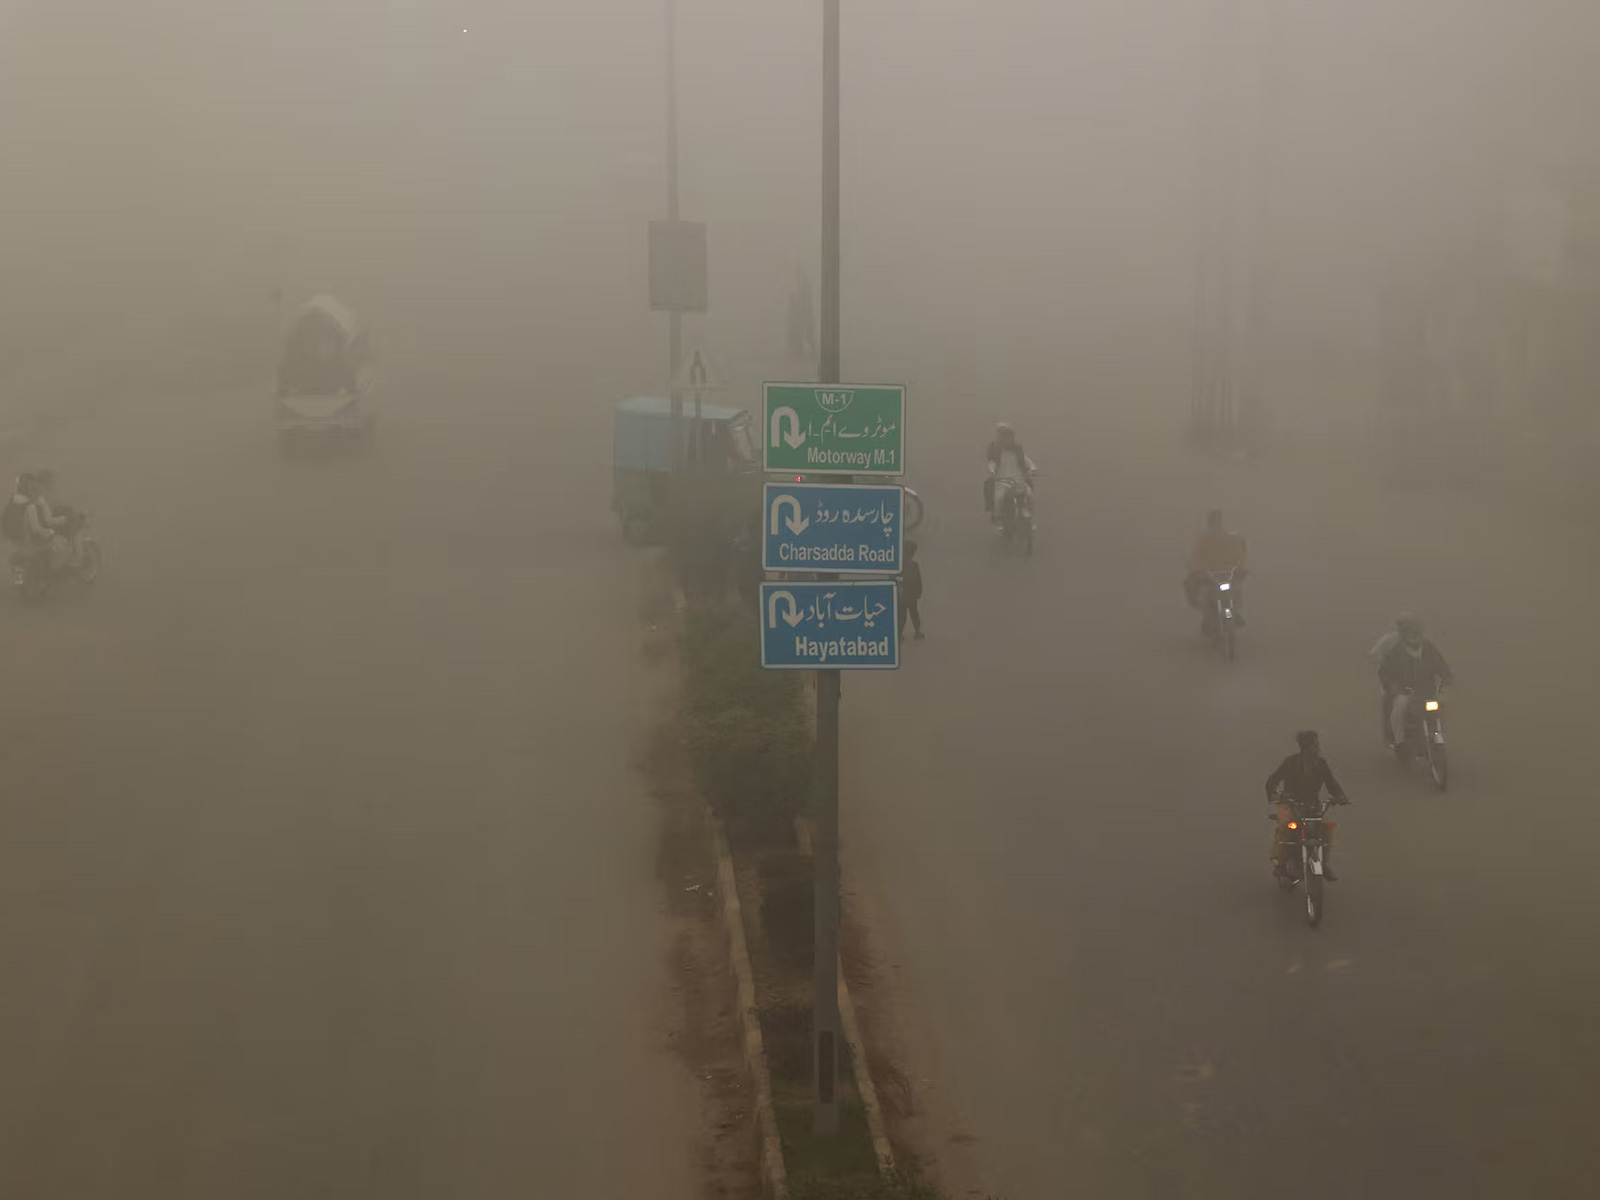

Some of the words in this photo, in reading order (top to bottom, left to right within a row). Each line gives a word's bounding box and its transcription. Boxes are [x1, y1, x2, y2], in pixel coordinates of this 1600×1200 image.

[822, 393, 846, 405] M-1
[807, 447, 872, 469] Motorway
[874, 449, 895, 465] M-1
[814, 499, 839, 524] روڈ
[841, 500, 895, 538] چارسدہ
[779, 543, 855, 561] Charsadda
[858, 544, 895, 562] Road
[805, 591, 837, 628] آباد
[835, 595, 887, 628] حیات
[795, 635, 889, 662] Hayatabad
